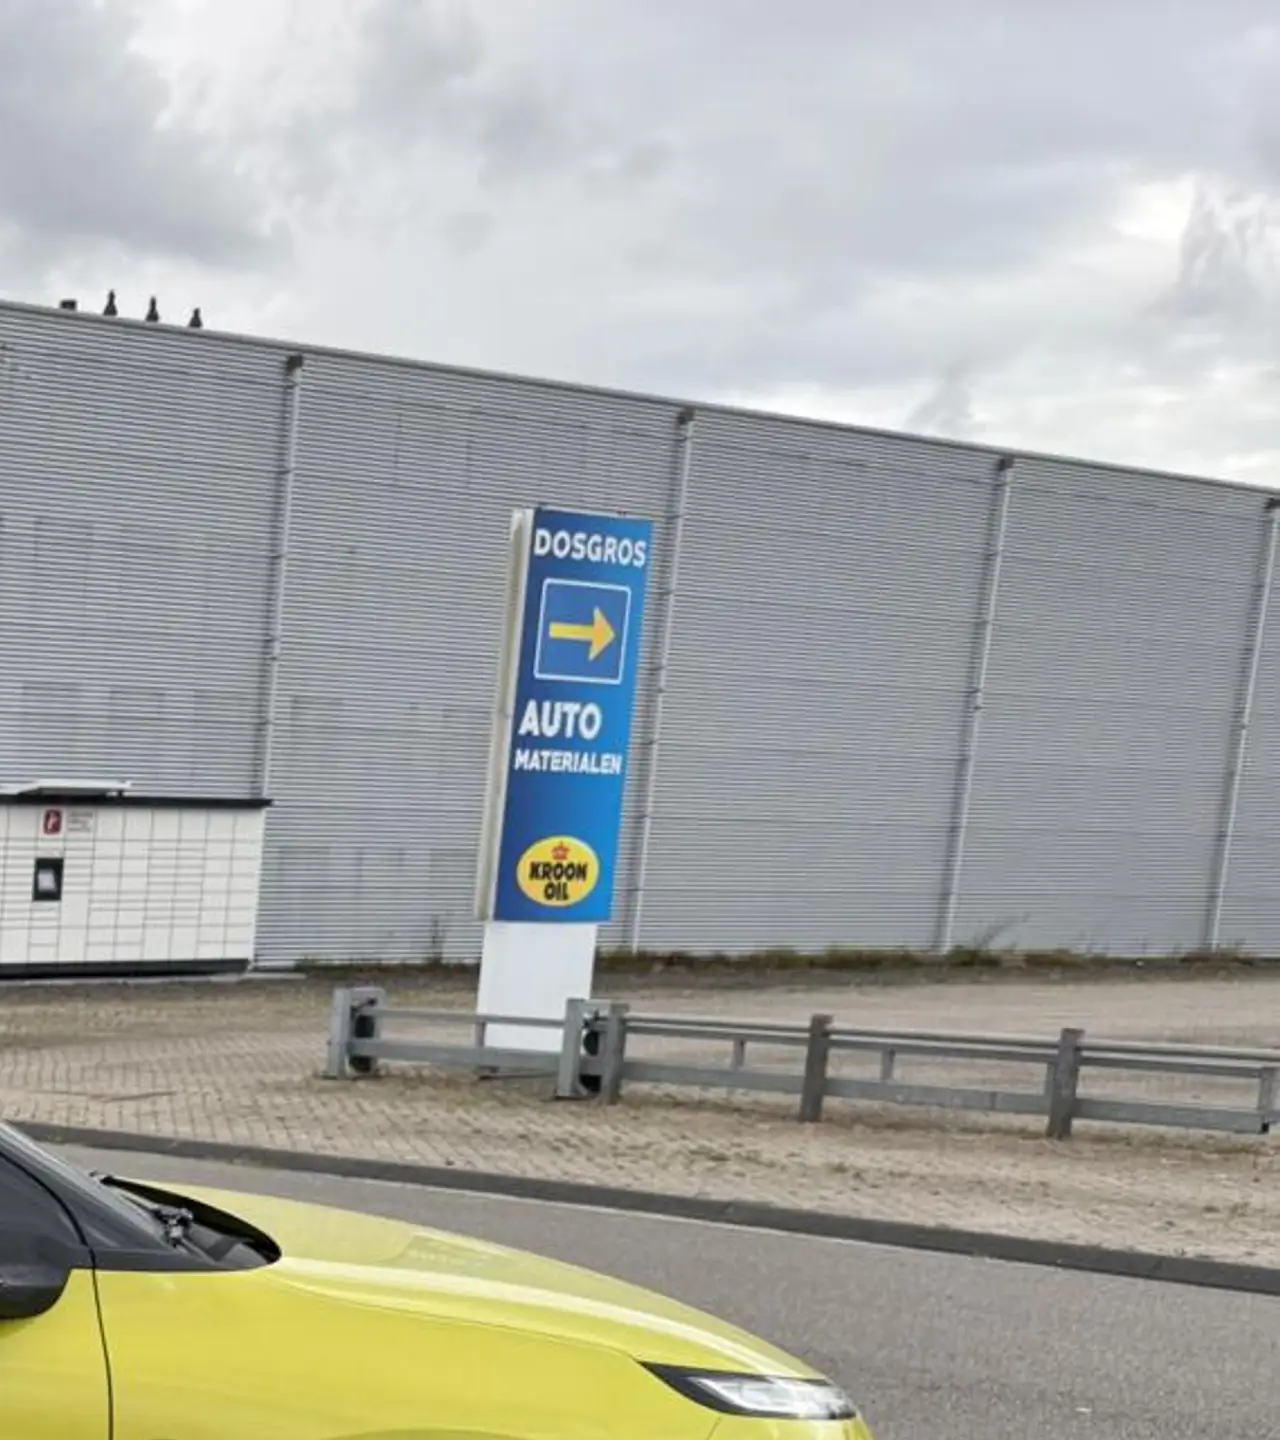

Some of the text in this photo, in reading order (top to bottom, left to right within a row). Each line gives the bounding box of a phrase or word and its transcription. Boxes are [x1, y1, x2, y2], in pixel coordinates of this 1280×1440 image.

[533, 528, 647, 567] DOSGROS
[518, 699, 603, 740] AUTO
[514, 747, 622, 776] MATERIALEN
[528, 861, 589, 882] KROON
[543, 880, 570, 901] OIL
